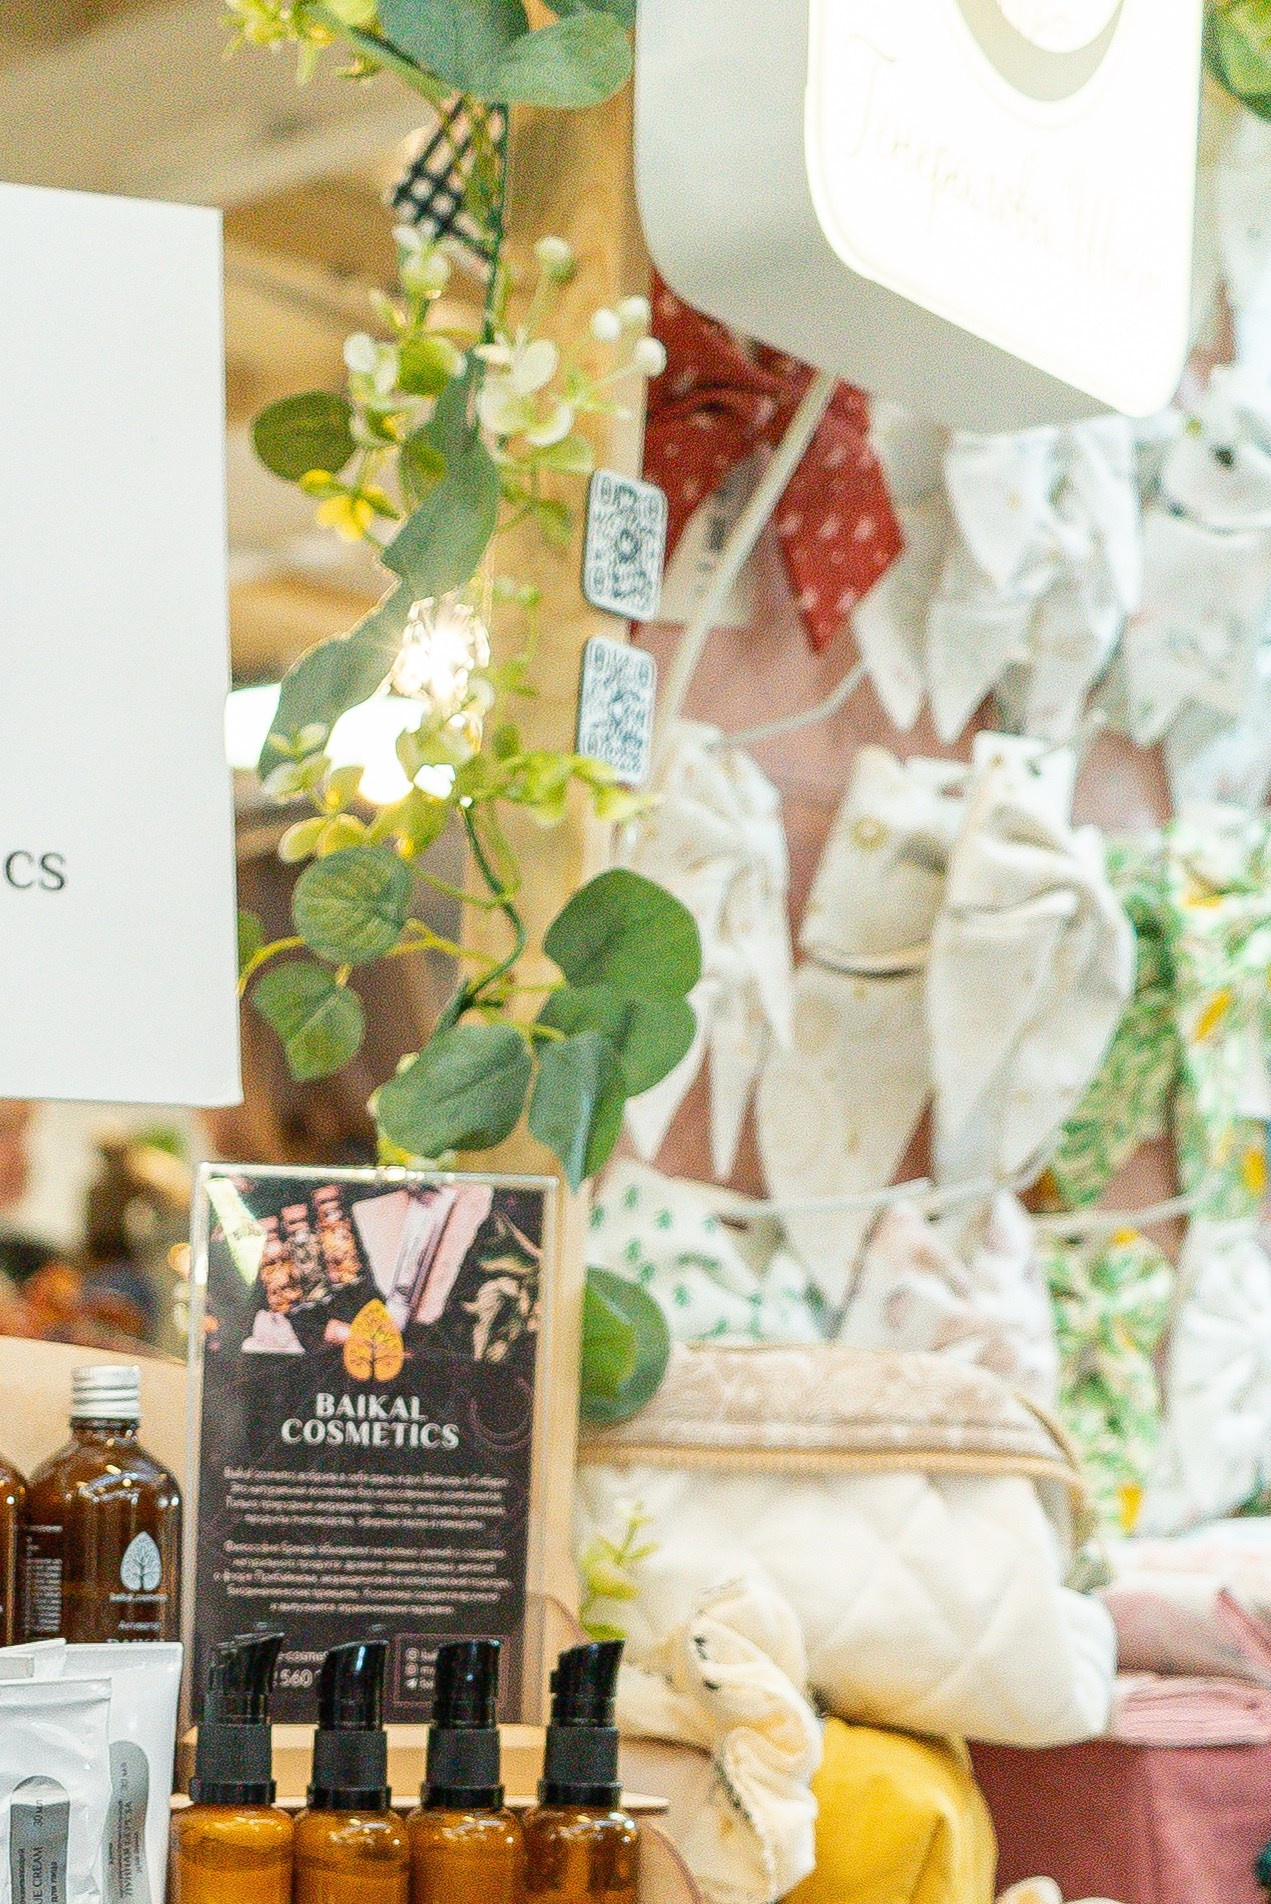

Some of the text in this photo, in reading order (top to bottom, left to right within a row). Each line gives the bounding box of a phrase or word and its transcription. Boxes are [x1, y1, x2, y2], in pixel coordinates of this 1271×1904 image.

[315, 1391, 427, 1422] BAIKAL
[281, 1417, 459, 1449] COSMETICS
[32, 1846, 44, 1888] CREAM
